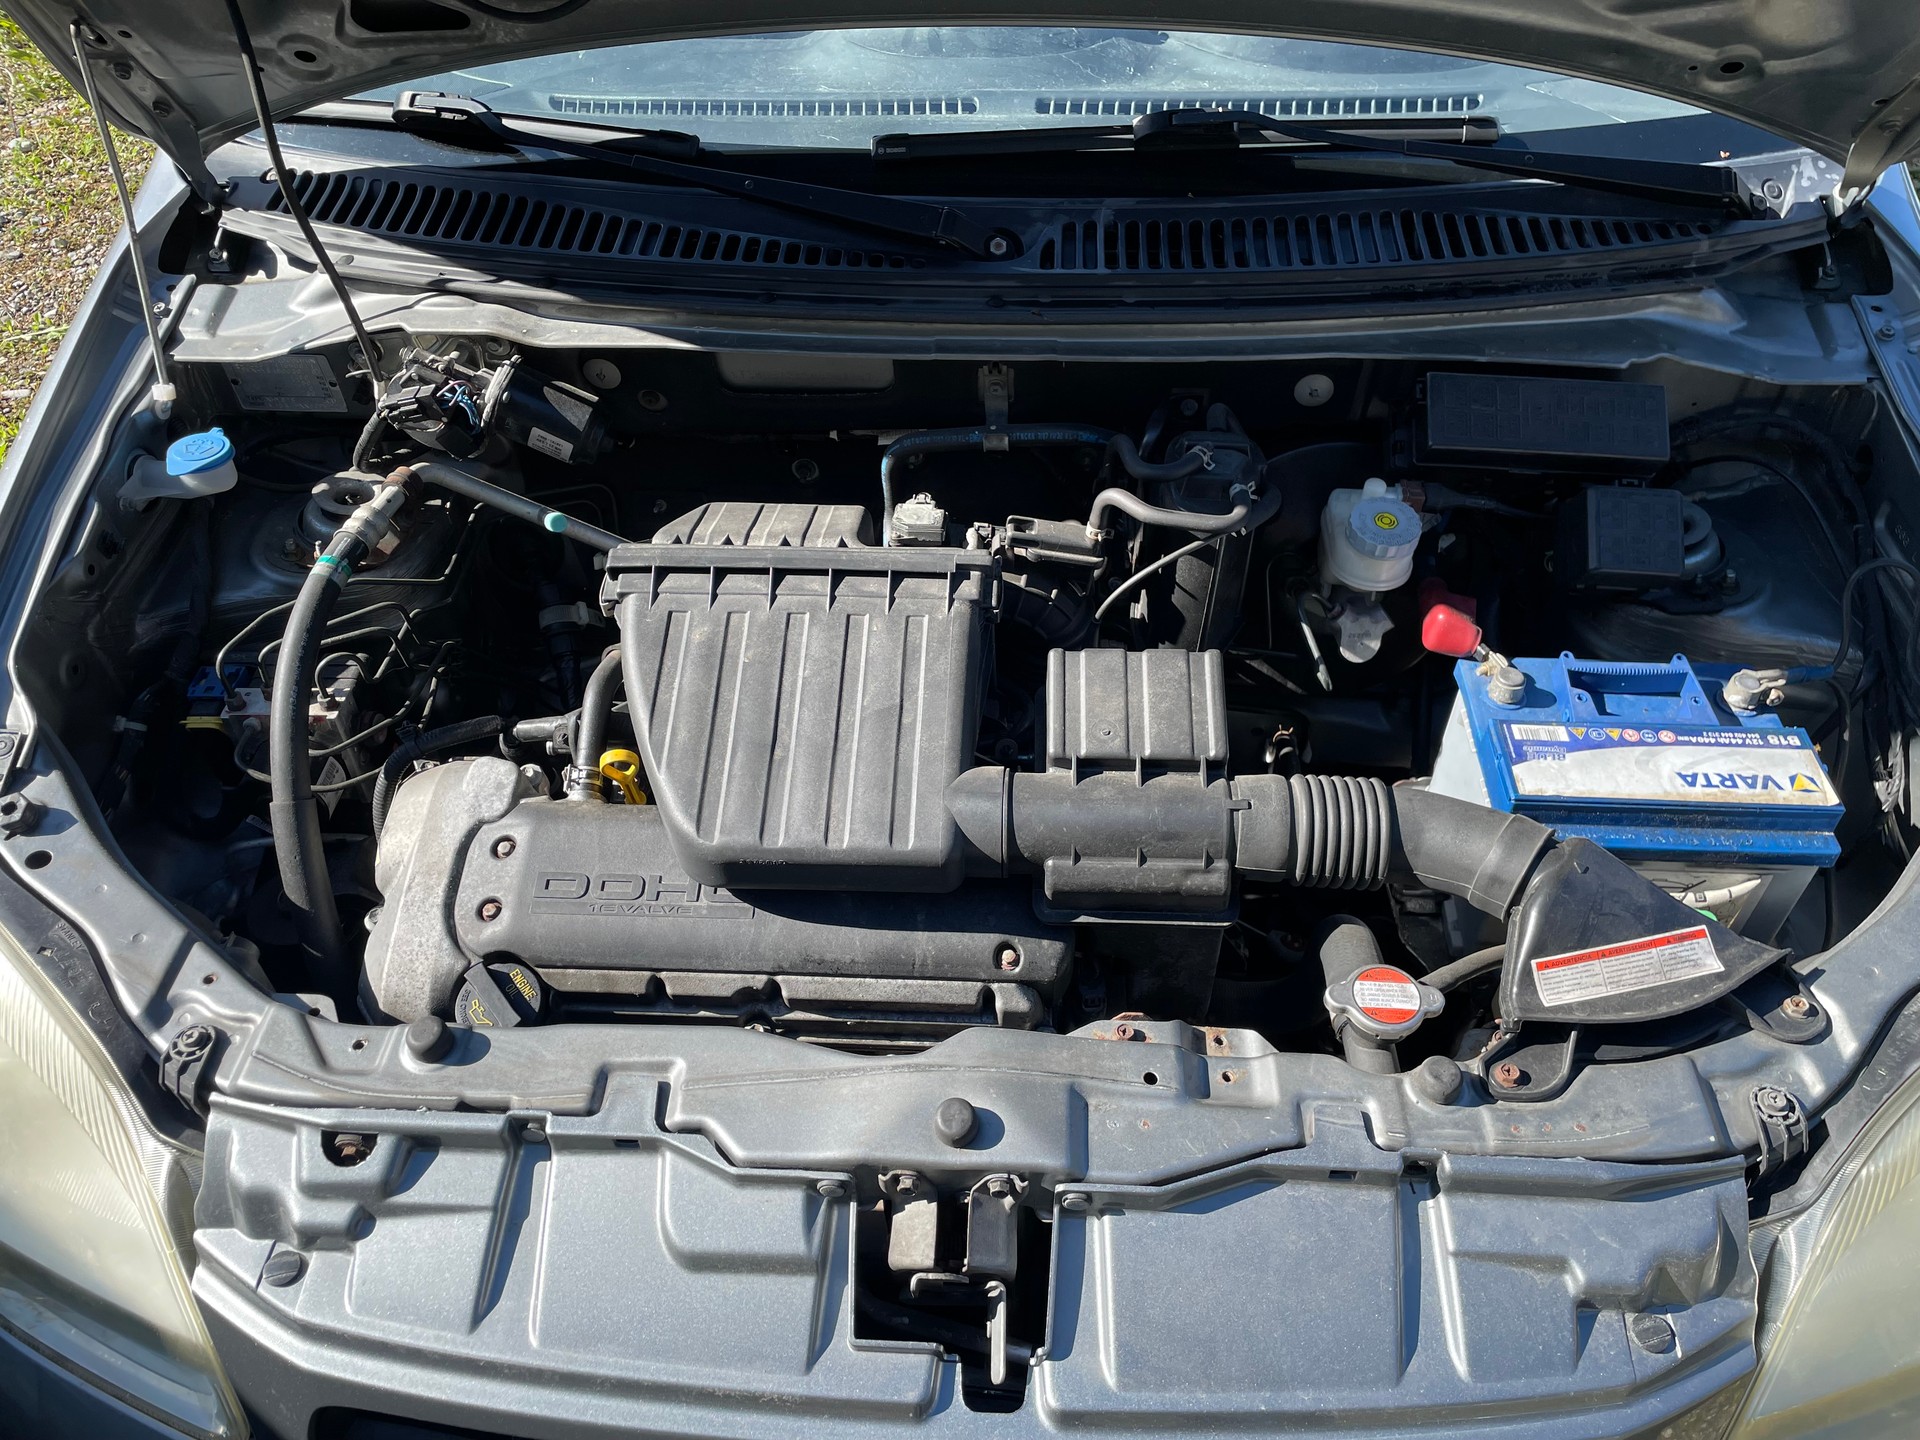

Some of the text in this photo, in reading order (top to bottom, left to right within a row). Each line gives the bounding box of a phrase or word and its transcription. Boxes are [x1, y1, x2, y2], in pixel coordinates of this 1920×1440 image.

[1717, 737, 1744, 745] 44Ah
[1766, 734, 1802, 746] B18
[1528, 751, 1567, 761] BLUE
[1675, 771, 1785, 791] VARTA
[56, 922, 86, 951] STANLEY
[1608, 942, 1654, 957] AVERTISSEMENT
[1551, 954, 1593, 967] ADVERTENCIA
[505, 983, 518, 1000] OIL
[510, 968, 537, 1001] ENGINE
[461, 989, 472, 1002] SEE
